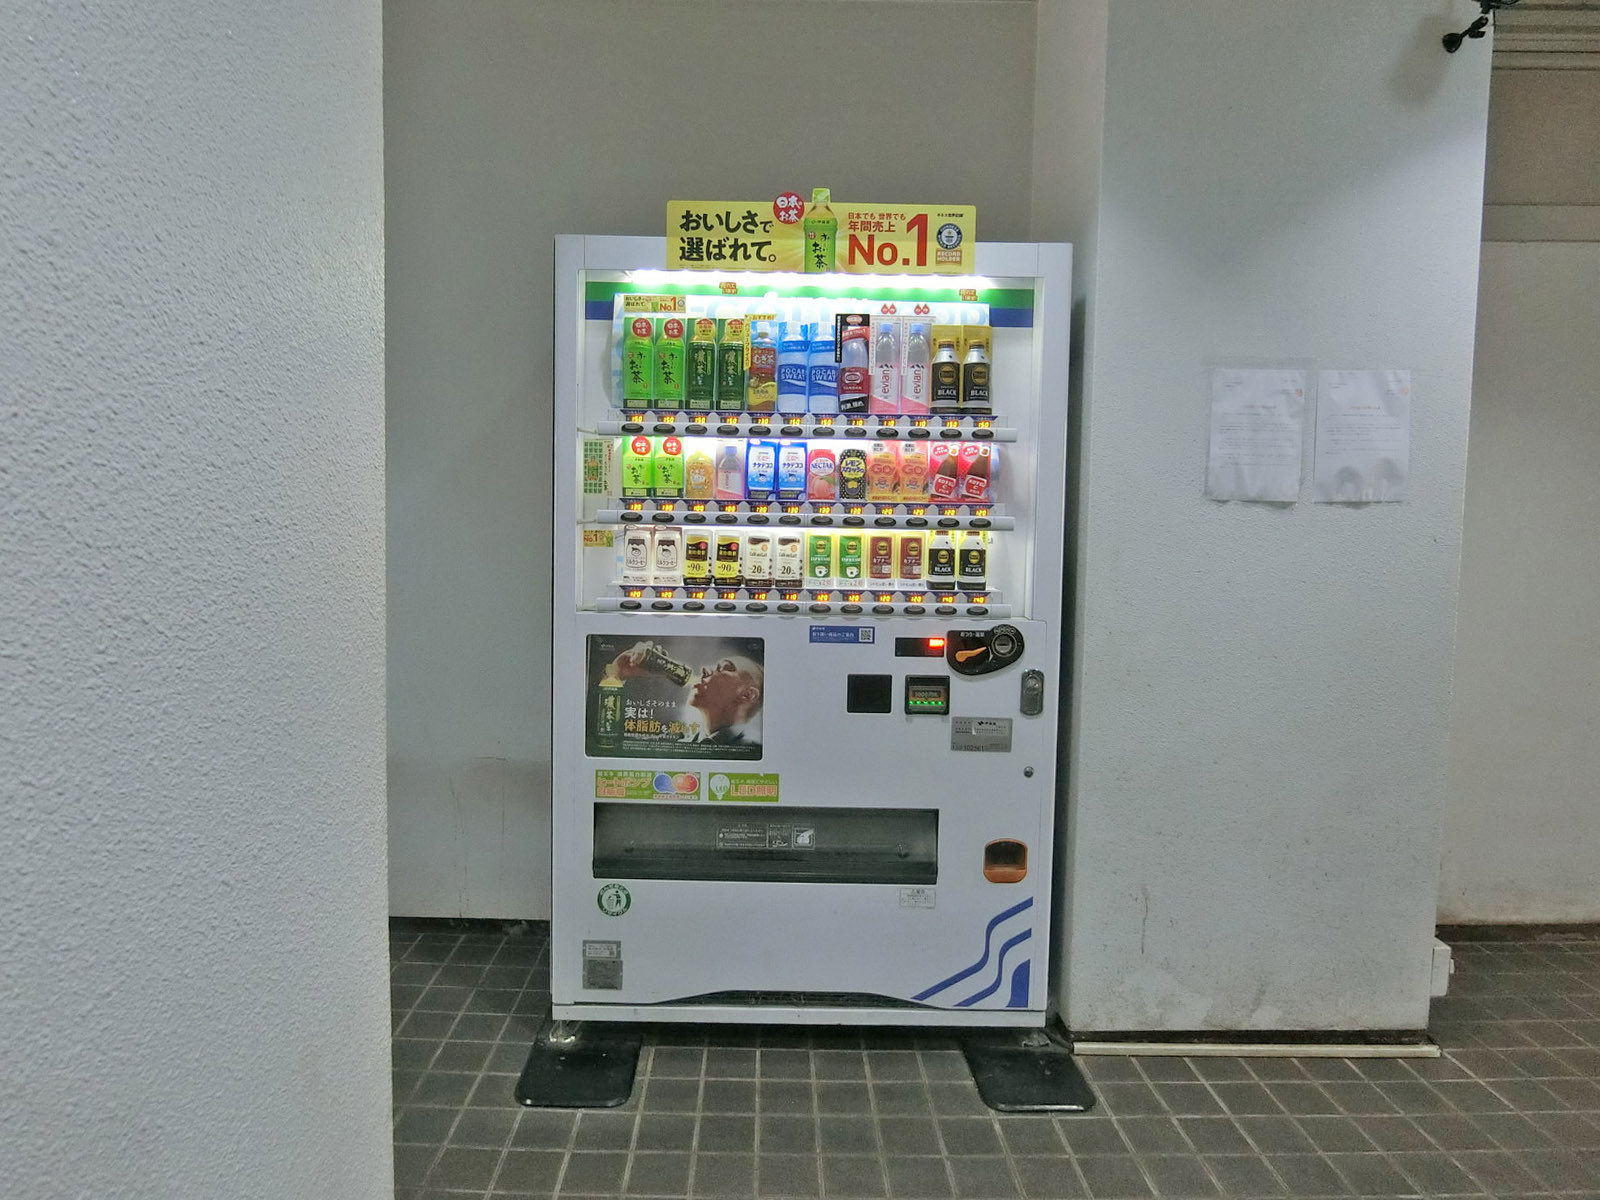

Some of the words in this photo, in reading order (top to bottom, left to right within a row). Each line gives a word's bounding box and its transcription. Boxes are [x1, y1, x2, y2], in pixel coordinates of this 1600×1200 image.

[679, 209, 775, 235] おいしさで
[779, 208, 800, 222] お茶
[847, 212, 877, 221] 日本でも
[878, 212, 907, 221] 世界でも
[847, 220, 897, 233] 年間売上
[679, 236, 777, 263] 選ばれて。
[847, 213, 929, 267] No.1
[881, 369, 890, 395] evian
[913, 369, 922, 395] evian
[625, 698, 677, 708] おいしさそのまま
